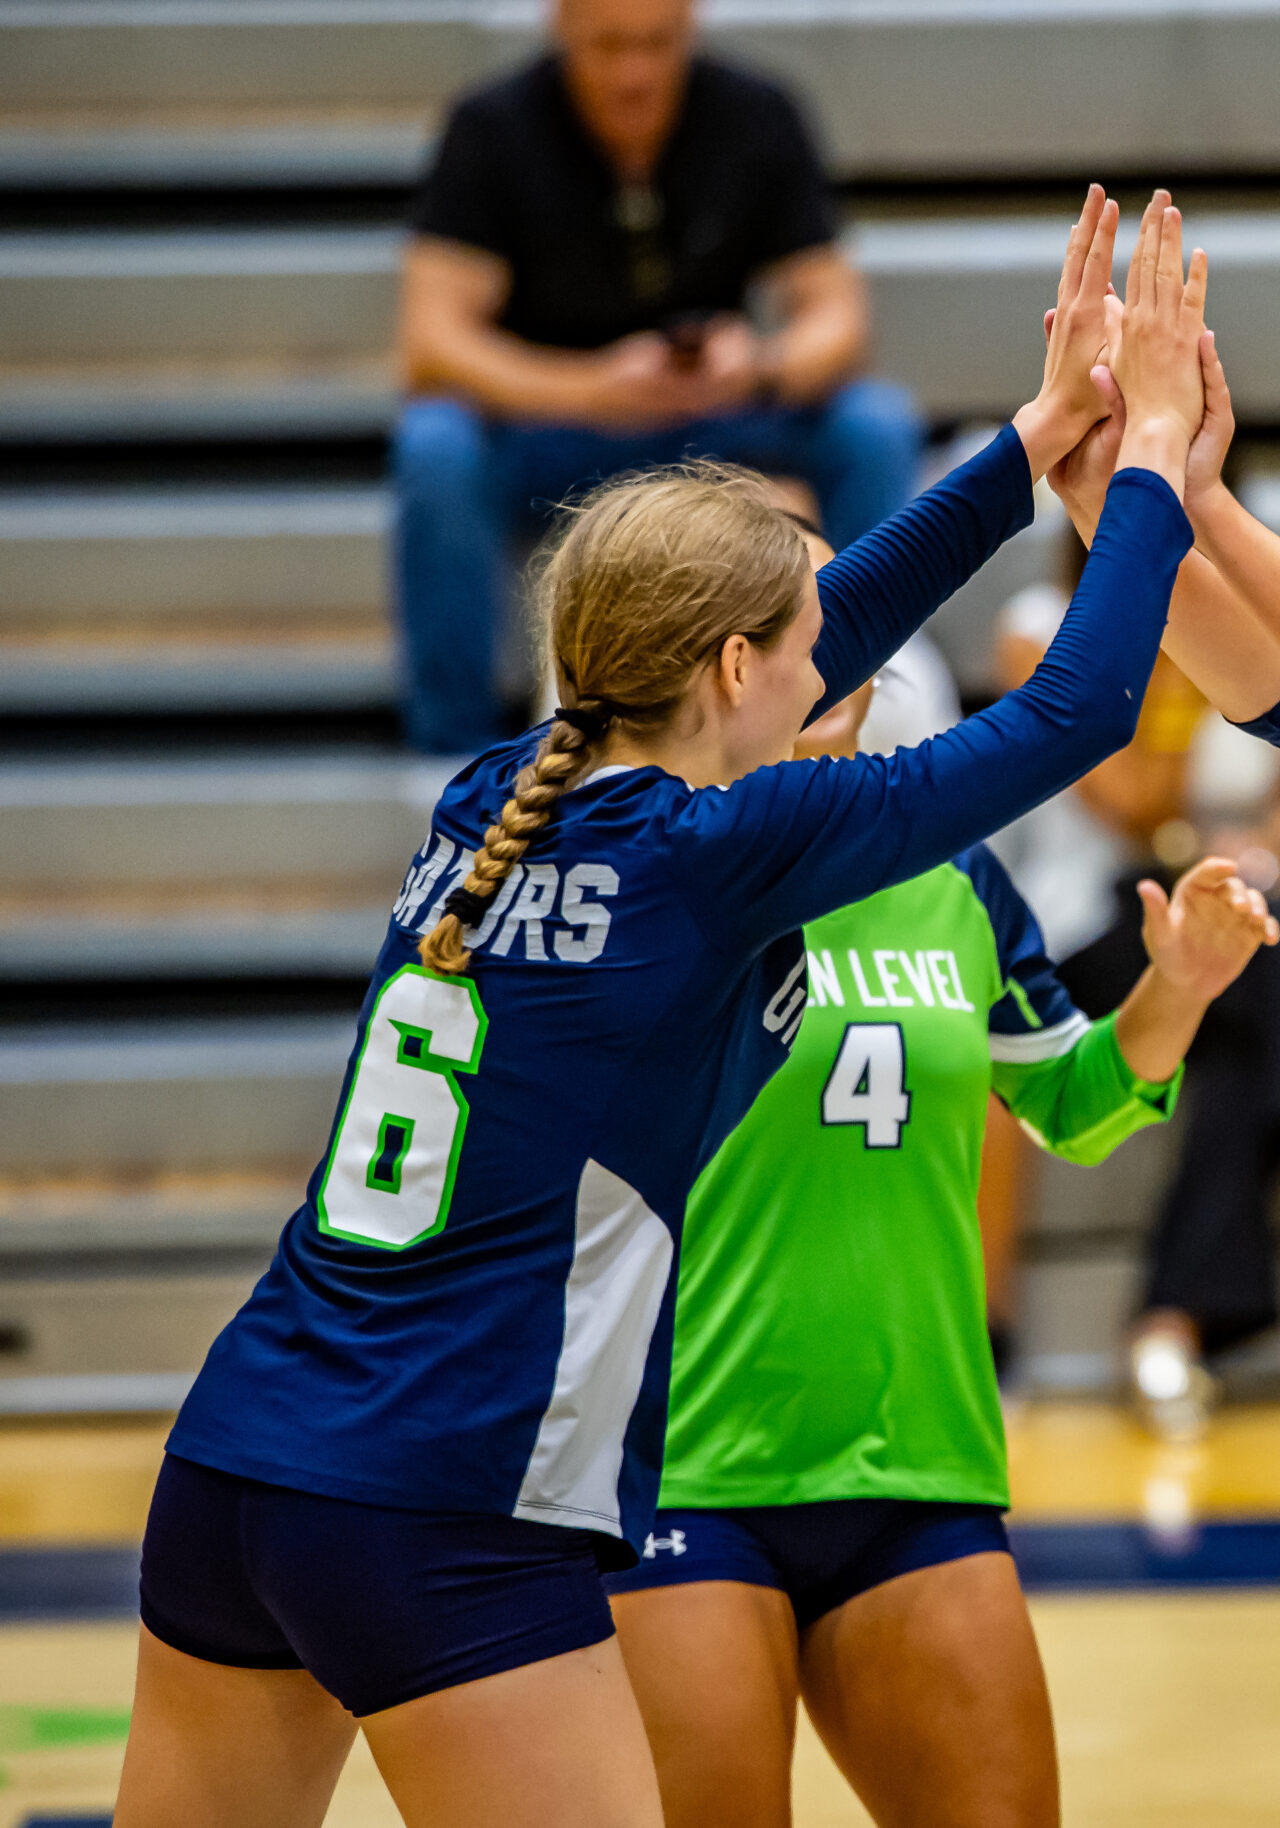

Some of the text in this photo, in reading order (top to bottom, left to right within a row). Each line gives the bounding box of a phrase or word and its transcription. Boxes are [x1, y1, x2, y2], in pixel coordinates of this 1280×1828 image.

[807, 949, 845, 1007] N
[848, 949, 975, 1013] LEVEL
[318, 962, 489, 1252] 6
[821, 1022, 912, 1149] 4
